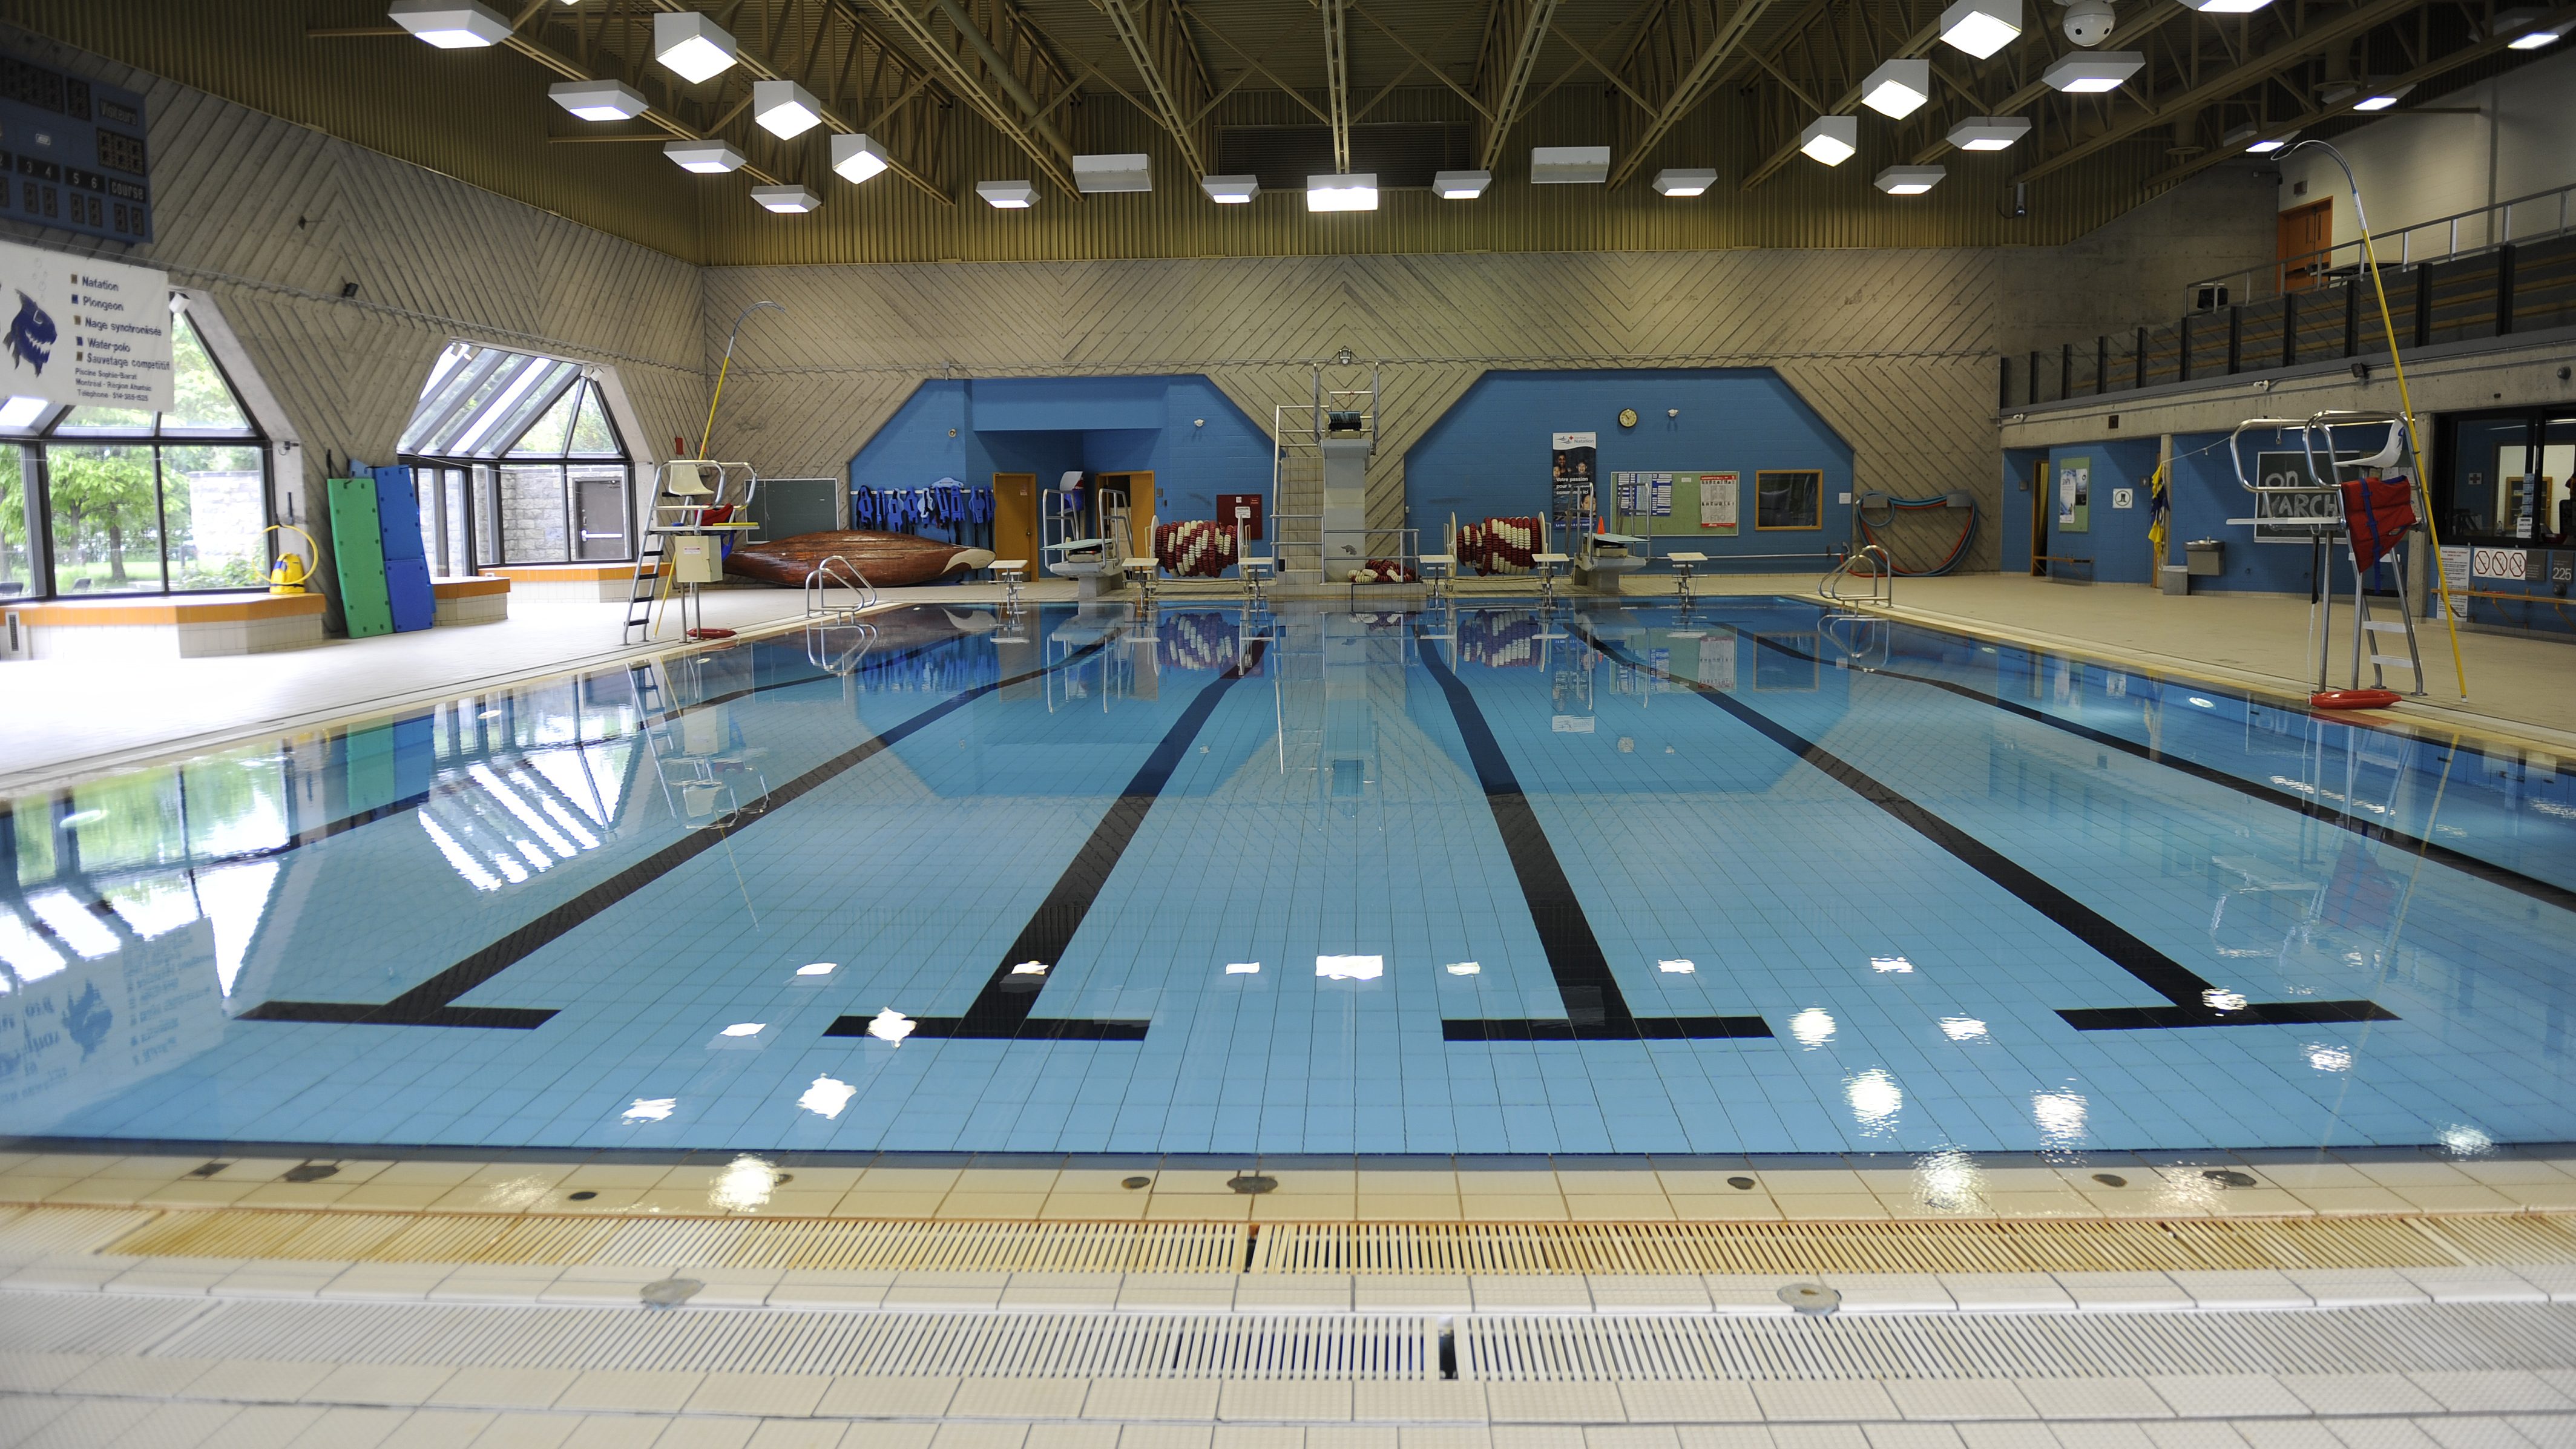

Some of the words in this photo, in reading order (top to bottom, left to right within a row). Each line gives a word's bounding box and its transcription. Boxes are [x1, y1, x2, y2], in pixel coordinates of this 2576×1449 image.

[100, 100, 137, 125] Visiteurs
[27, 161, 33, 174] 3
[45, 166, 51, 179] 4
[73, 172, 79, 184] 5
[91, 177, 97, 189] 6
[111, 182, 143, 200] course
[82, 276, 119, 291] Natation
[83, 295, 124, 311] Plongeon
[85, 317, 108, 331] Nage
[87, 337, 131, 353] Water-polo
[87, 353, 128, 368] Sauvetage
[75, 367, 96, 376] Piscine
[2552, 567, 2572, 580] 225
